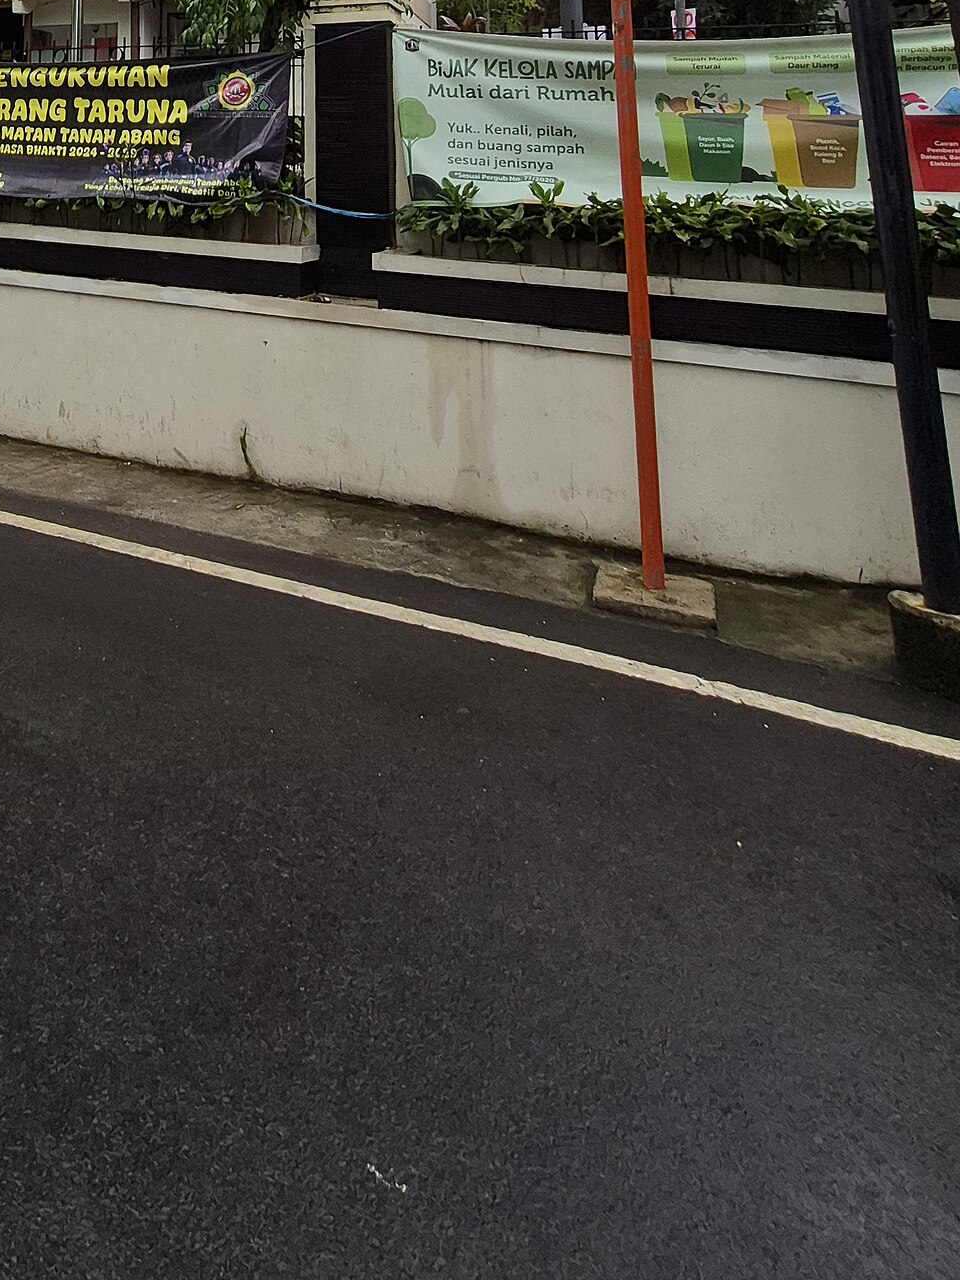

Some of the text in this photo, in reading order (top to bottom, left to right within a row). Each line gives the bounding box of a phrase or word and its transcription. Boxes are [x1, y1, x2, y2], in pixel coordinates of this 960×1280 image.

[811, 62, 839, 70] Ulang
[900, 55, 952, 63] Berbahaya
[484, 58, 558, 80] KELOLA
[564, 60, 637, 81] SAMP
[427, 83, 616, 102] Mulai dari Rumah
[74, 97, 188, 124] TARUNA
[60, 127, 117, 144] TANAH
[119, 129, 181, 146] ABANG
[448, 122, 577, 139] Yuk.. Kenali, pilah,
[26, 145, 67, 157] BHAKTI
[69, 146, 98, 159] 2024
[448, 139, 585, 157] dan buang sampah
[448, 155, 554, 173] sesuai jenisnya
[196, 178, 223, 187] Tanah
[181, 186, 215, 197] Kreatif
[217, 189, 236, 199] Dan
